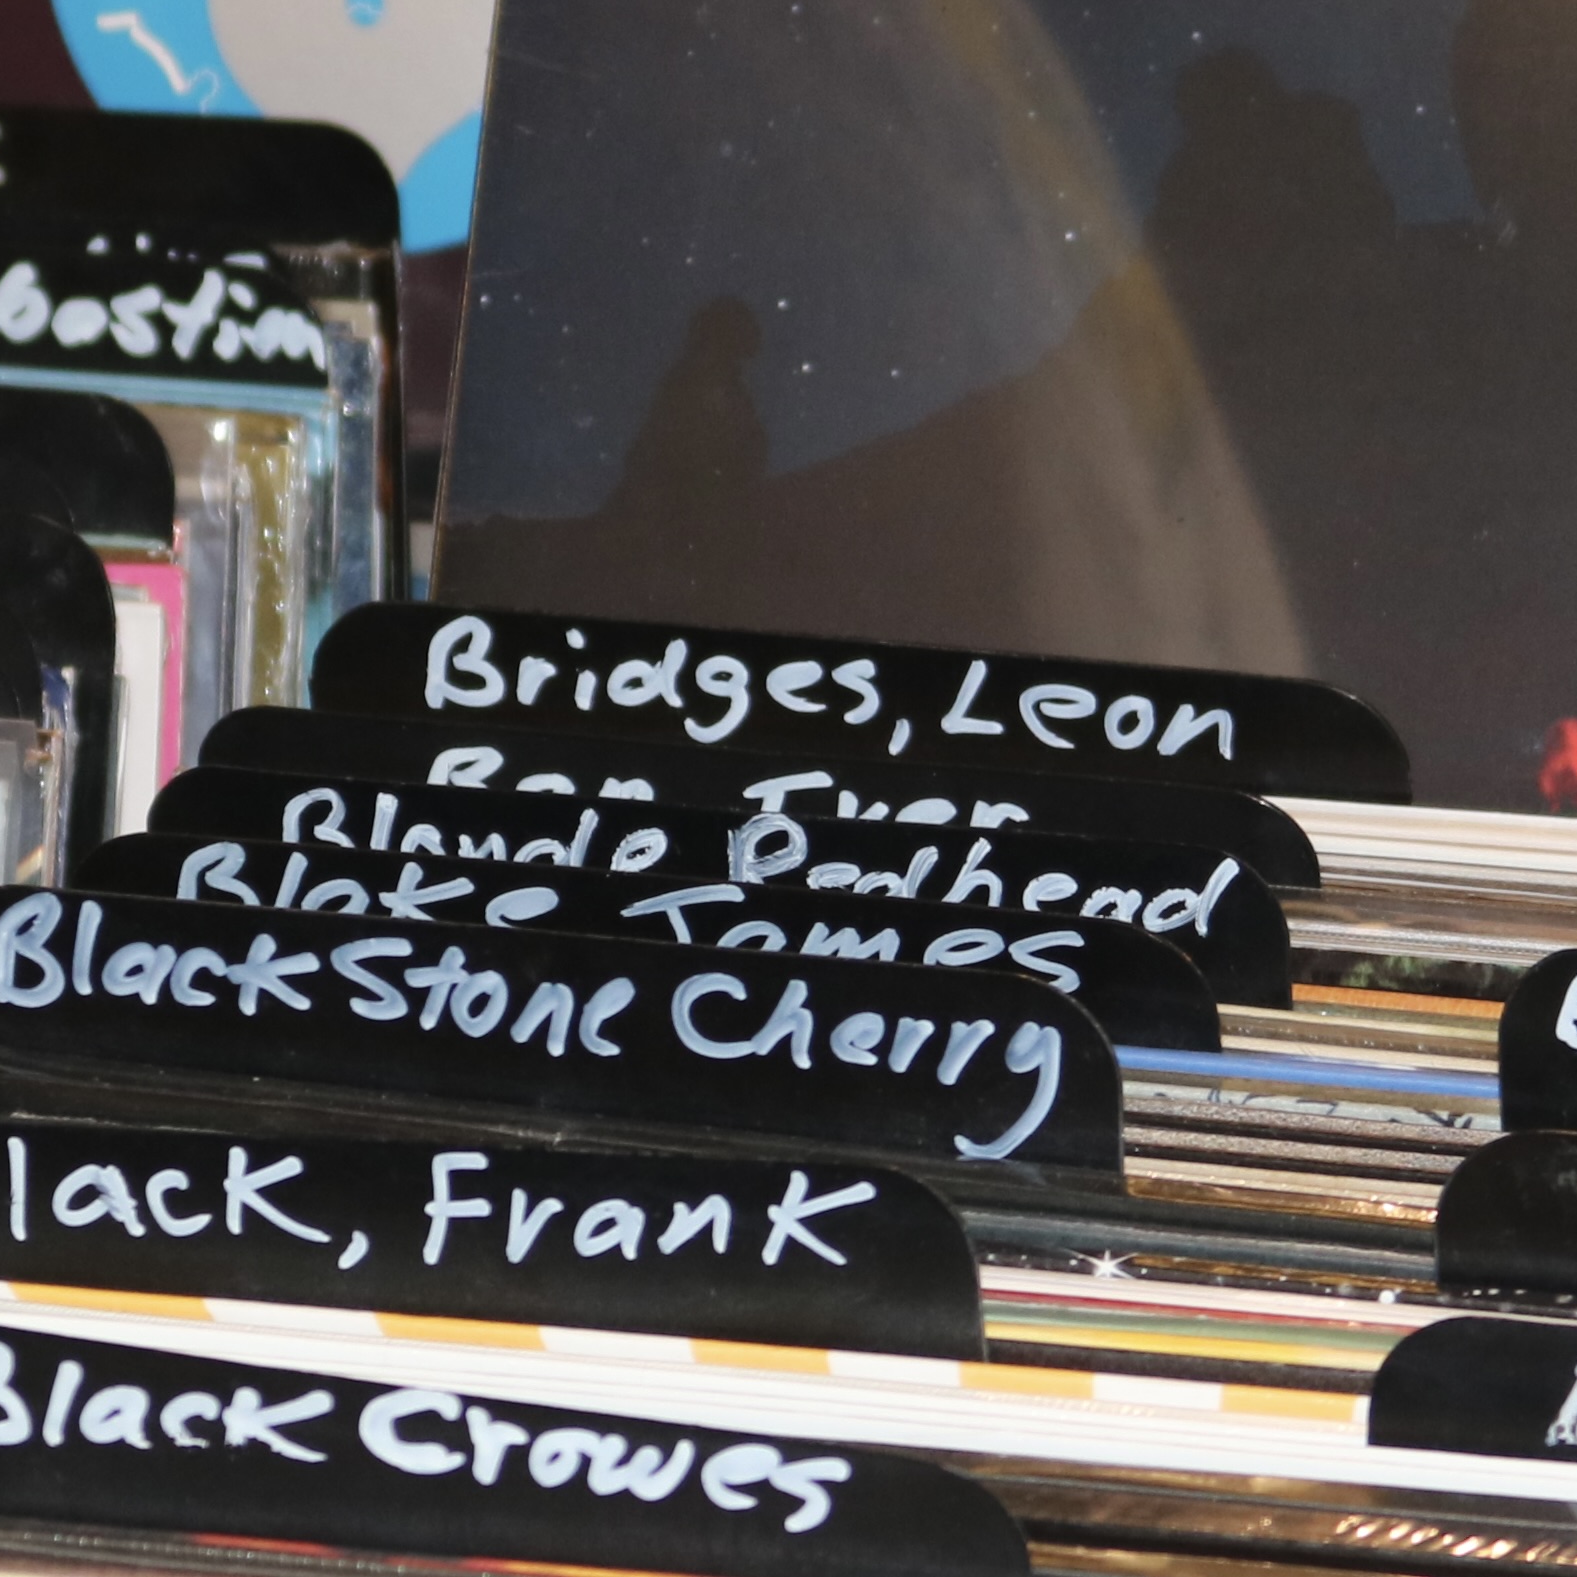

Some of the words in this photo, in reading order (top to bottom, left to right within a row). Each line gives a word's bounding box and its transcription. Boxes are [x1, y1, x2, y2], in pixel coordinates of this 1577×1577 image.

[422, 614, 911, 757] Bridges,
[940, 658, 1236, 762] Leon
[668, 969, 1064, 1163] Cherry
[422, 1151, 877, 1270] Frank
[358, 1384, 854, 1535] Crowes
